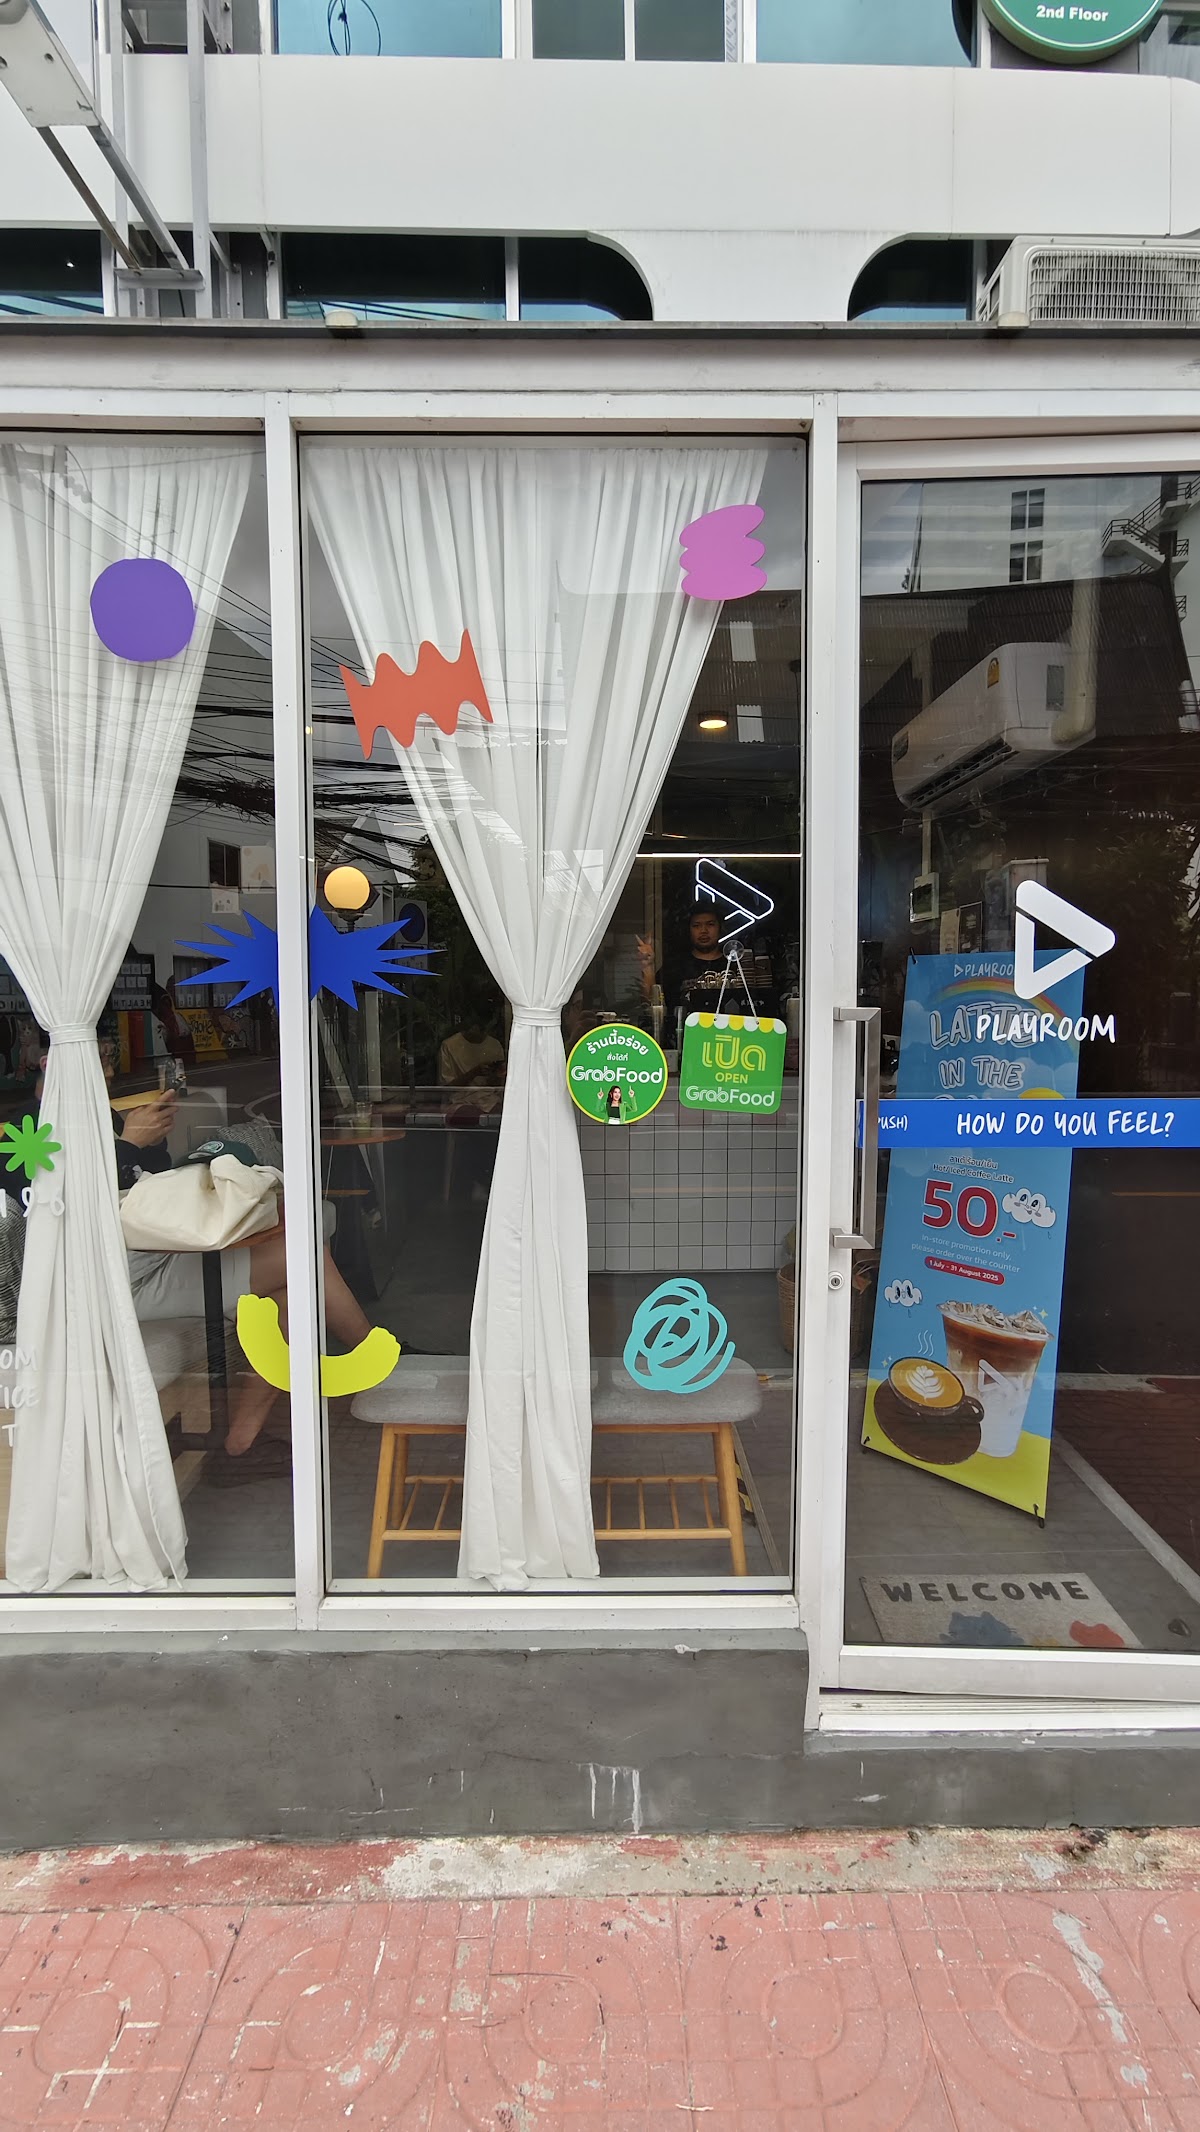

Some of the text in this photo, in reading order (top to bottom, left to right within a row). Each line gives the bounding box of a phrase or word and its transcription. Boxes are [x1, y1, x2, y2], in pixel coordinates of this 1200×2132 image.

[1036, 5, 1109, 22] 2nd Floor
[964, 962, 1015, 977] PLAYROO
[976, 1012, 1116, 1044] PLAYROOM
[586, 1029, 649, 1055] ร้านนี้อร่อย
[702, 1034, 766, 1071] เปิด
[571, 1065, 663, 1083] GrabFood
[715, 1072, 748, 1084] OPEN
[939, 1055, 1025, 1091] IN THE
[686, 1086, 775, 1106] GrabFood
[956, 1109, 1175, 1137] HOW DO YOU FEEL?
[966, 1168, 991, 1180] Coffee
[992, 1173, 1014, 1183] Latte
[921, 1234, 950, 1247] In-store
[951, 1241, 991, 1256] promotion
[911, 1242, 1021, 1273] please order over the counter
[933, 1260, 945, 1270] July
[958, 1267, 981, 1277] August
[982, 1272, 999, 1281] 2025
[880, 1581, 1090, 1602] WELCOME
